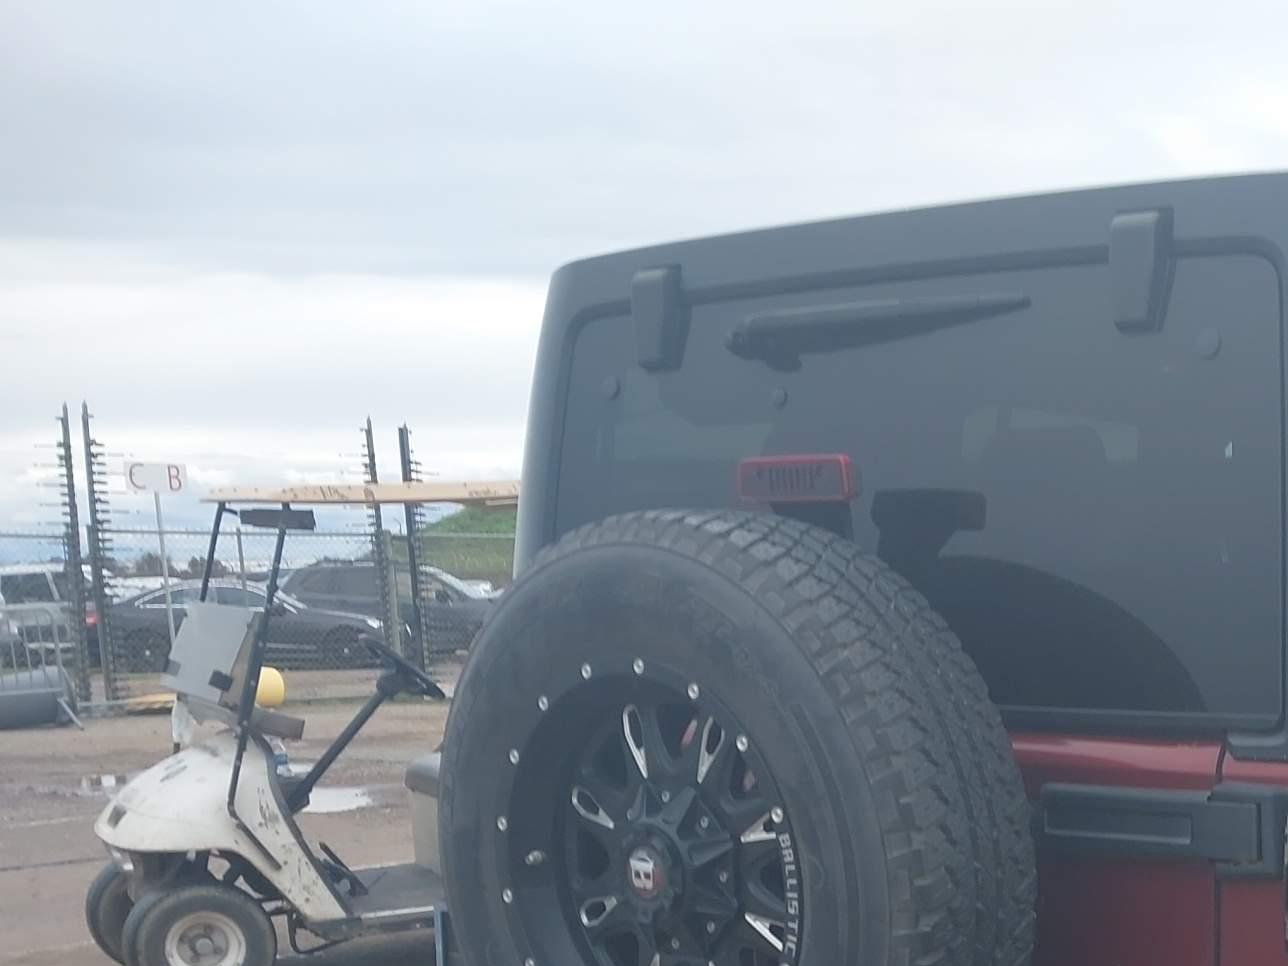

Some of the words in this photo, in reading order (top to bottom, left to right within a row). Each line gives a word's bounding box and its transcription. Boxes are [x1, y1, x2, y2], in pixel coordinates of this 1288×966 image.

[129, 463, 146, 490] C
[167, 464, 182, 491] B
[778, 833, 799, 957] BALLISTIC
